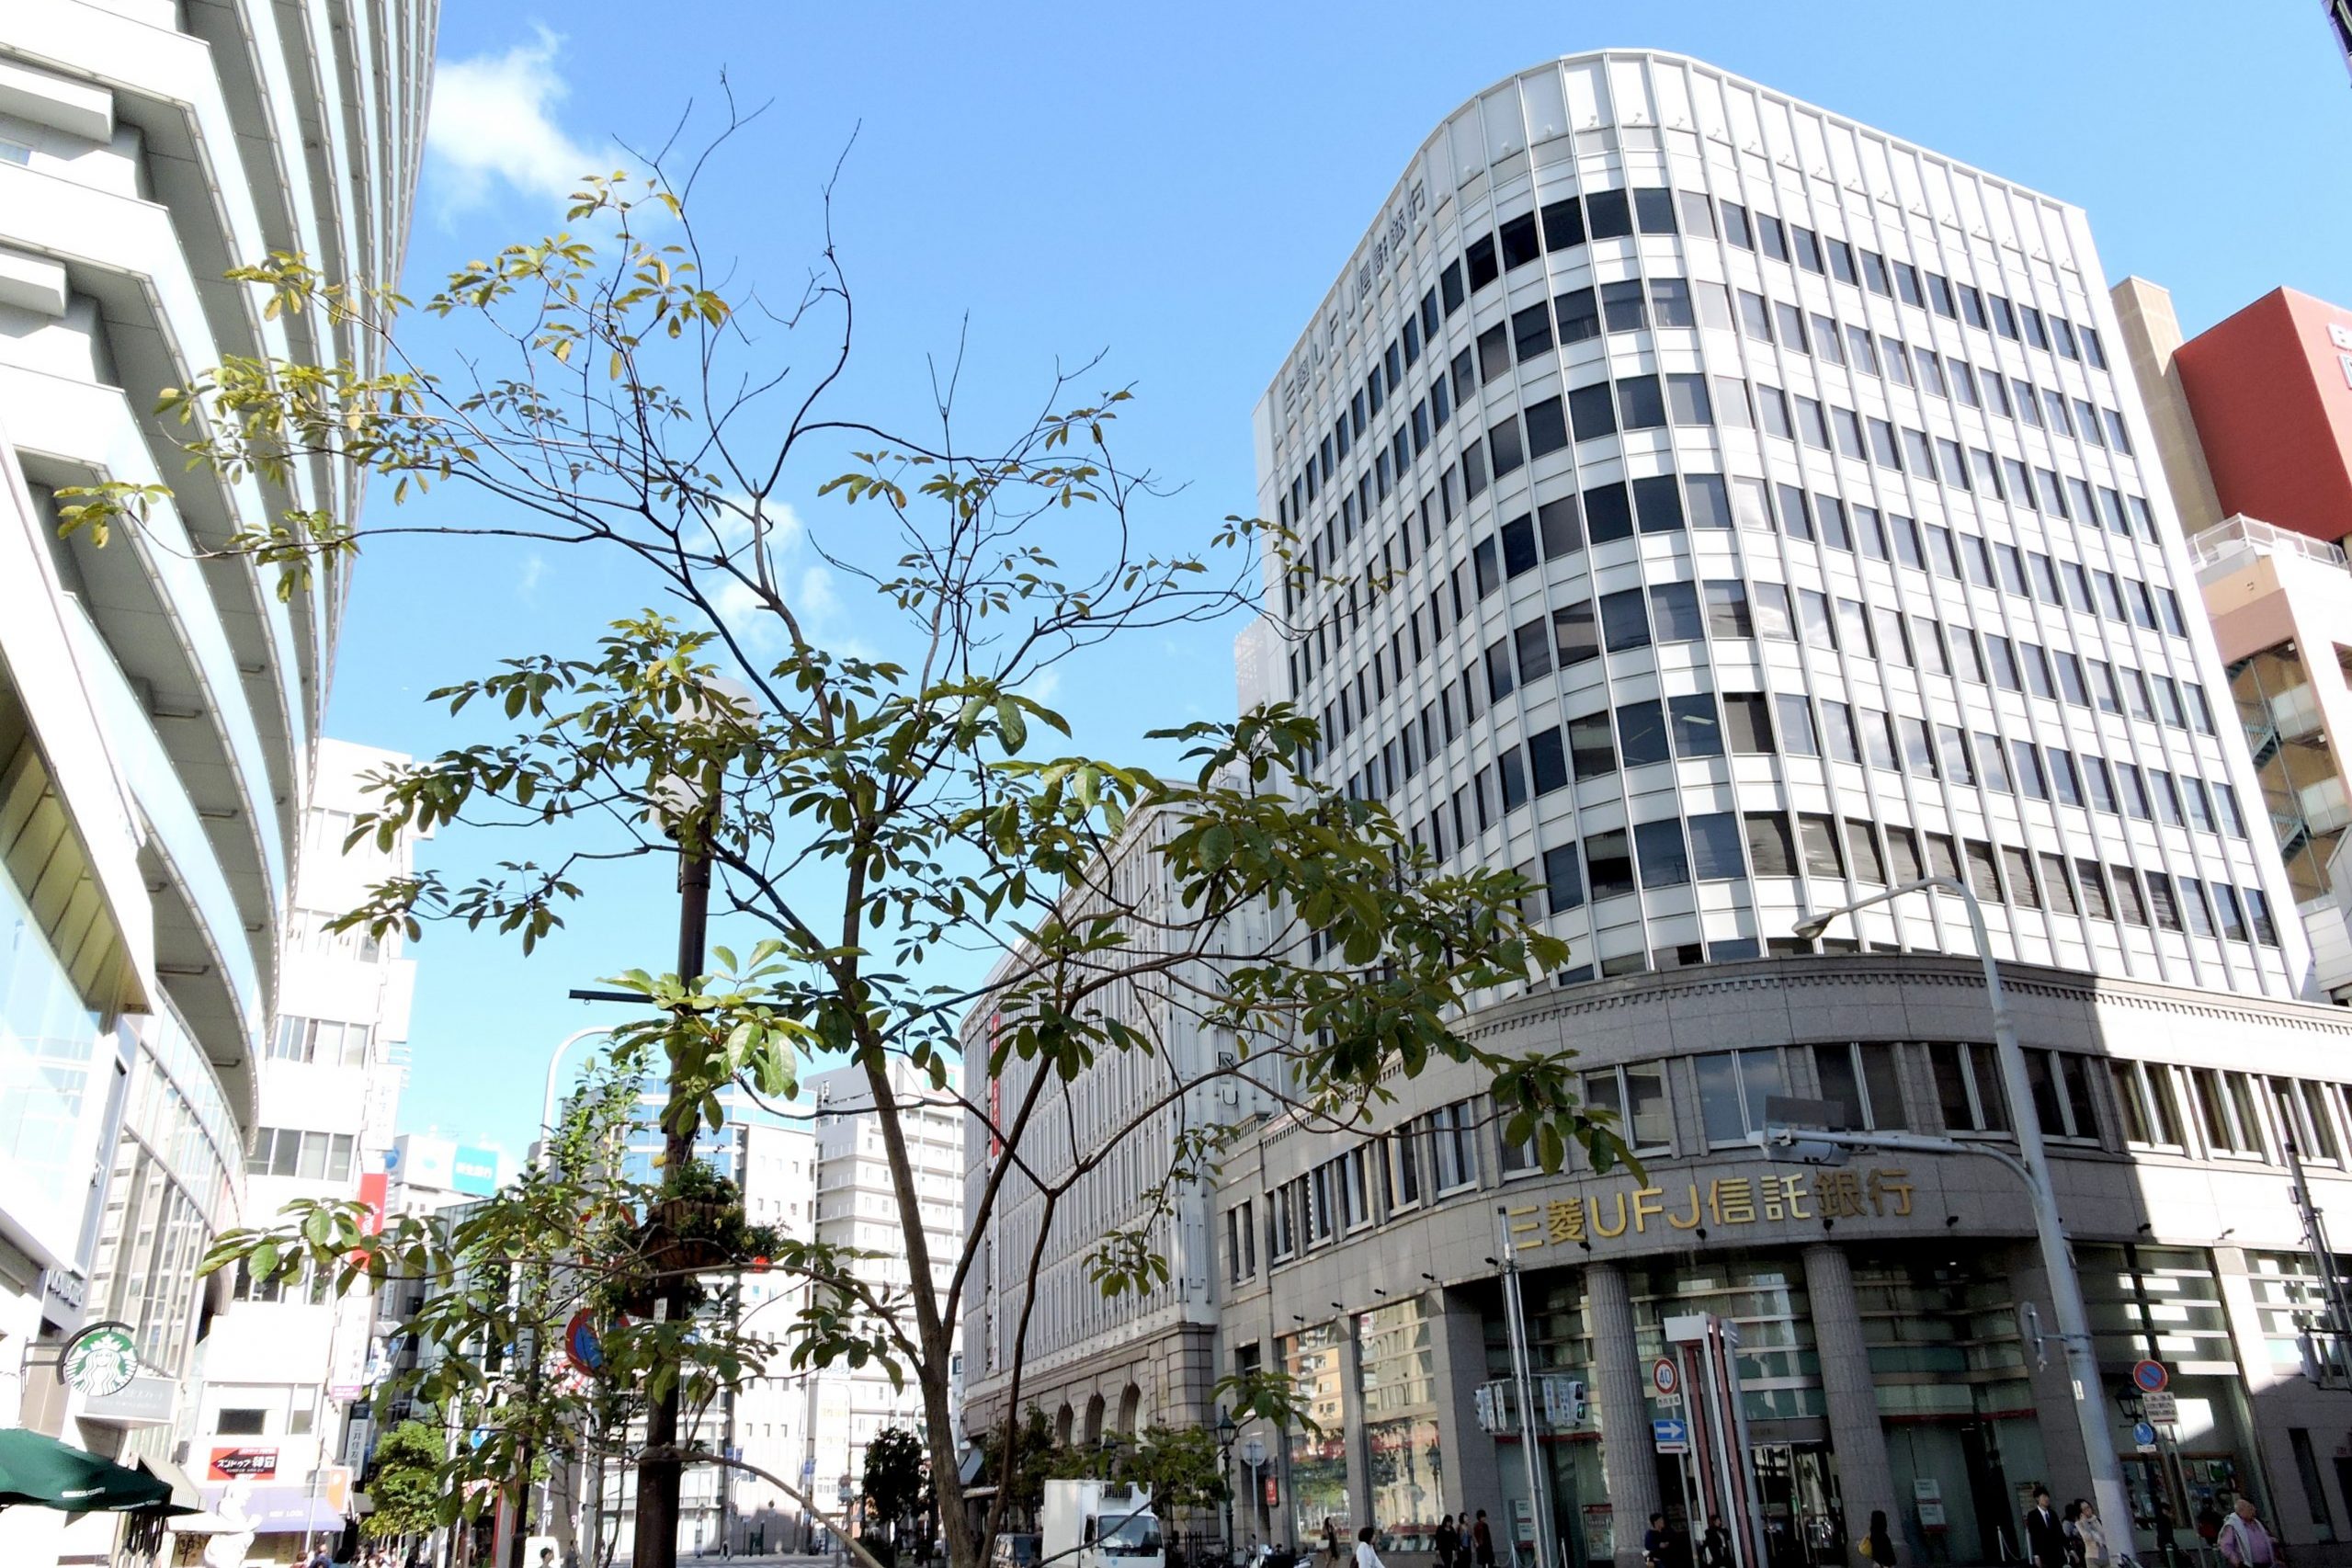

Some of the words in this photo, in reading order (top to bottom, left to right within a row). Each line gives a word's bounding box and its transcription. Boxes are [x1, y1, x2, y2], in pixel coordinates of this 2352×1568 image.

[1509, 1168, 1914, 1251] 三菱UFJ信託銀行
[1659, 1369, 1672, 1384] 40
